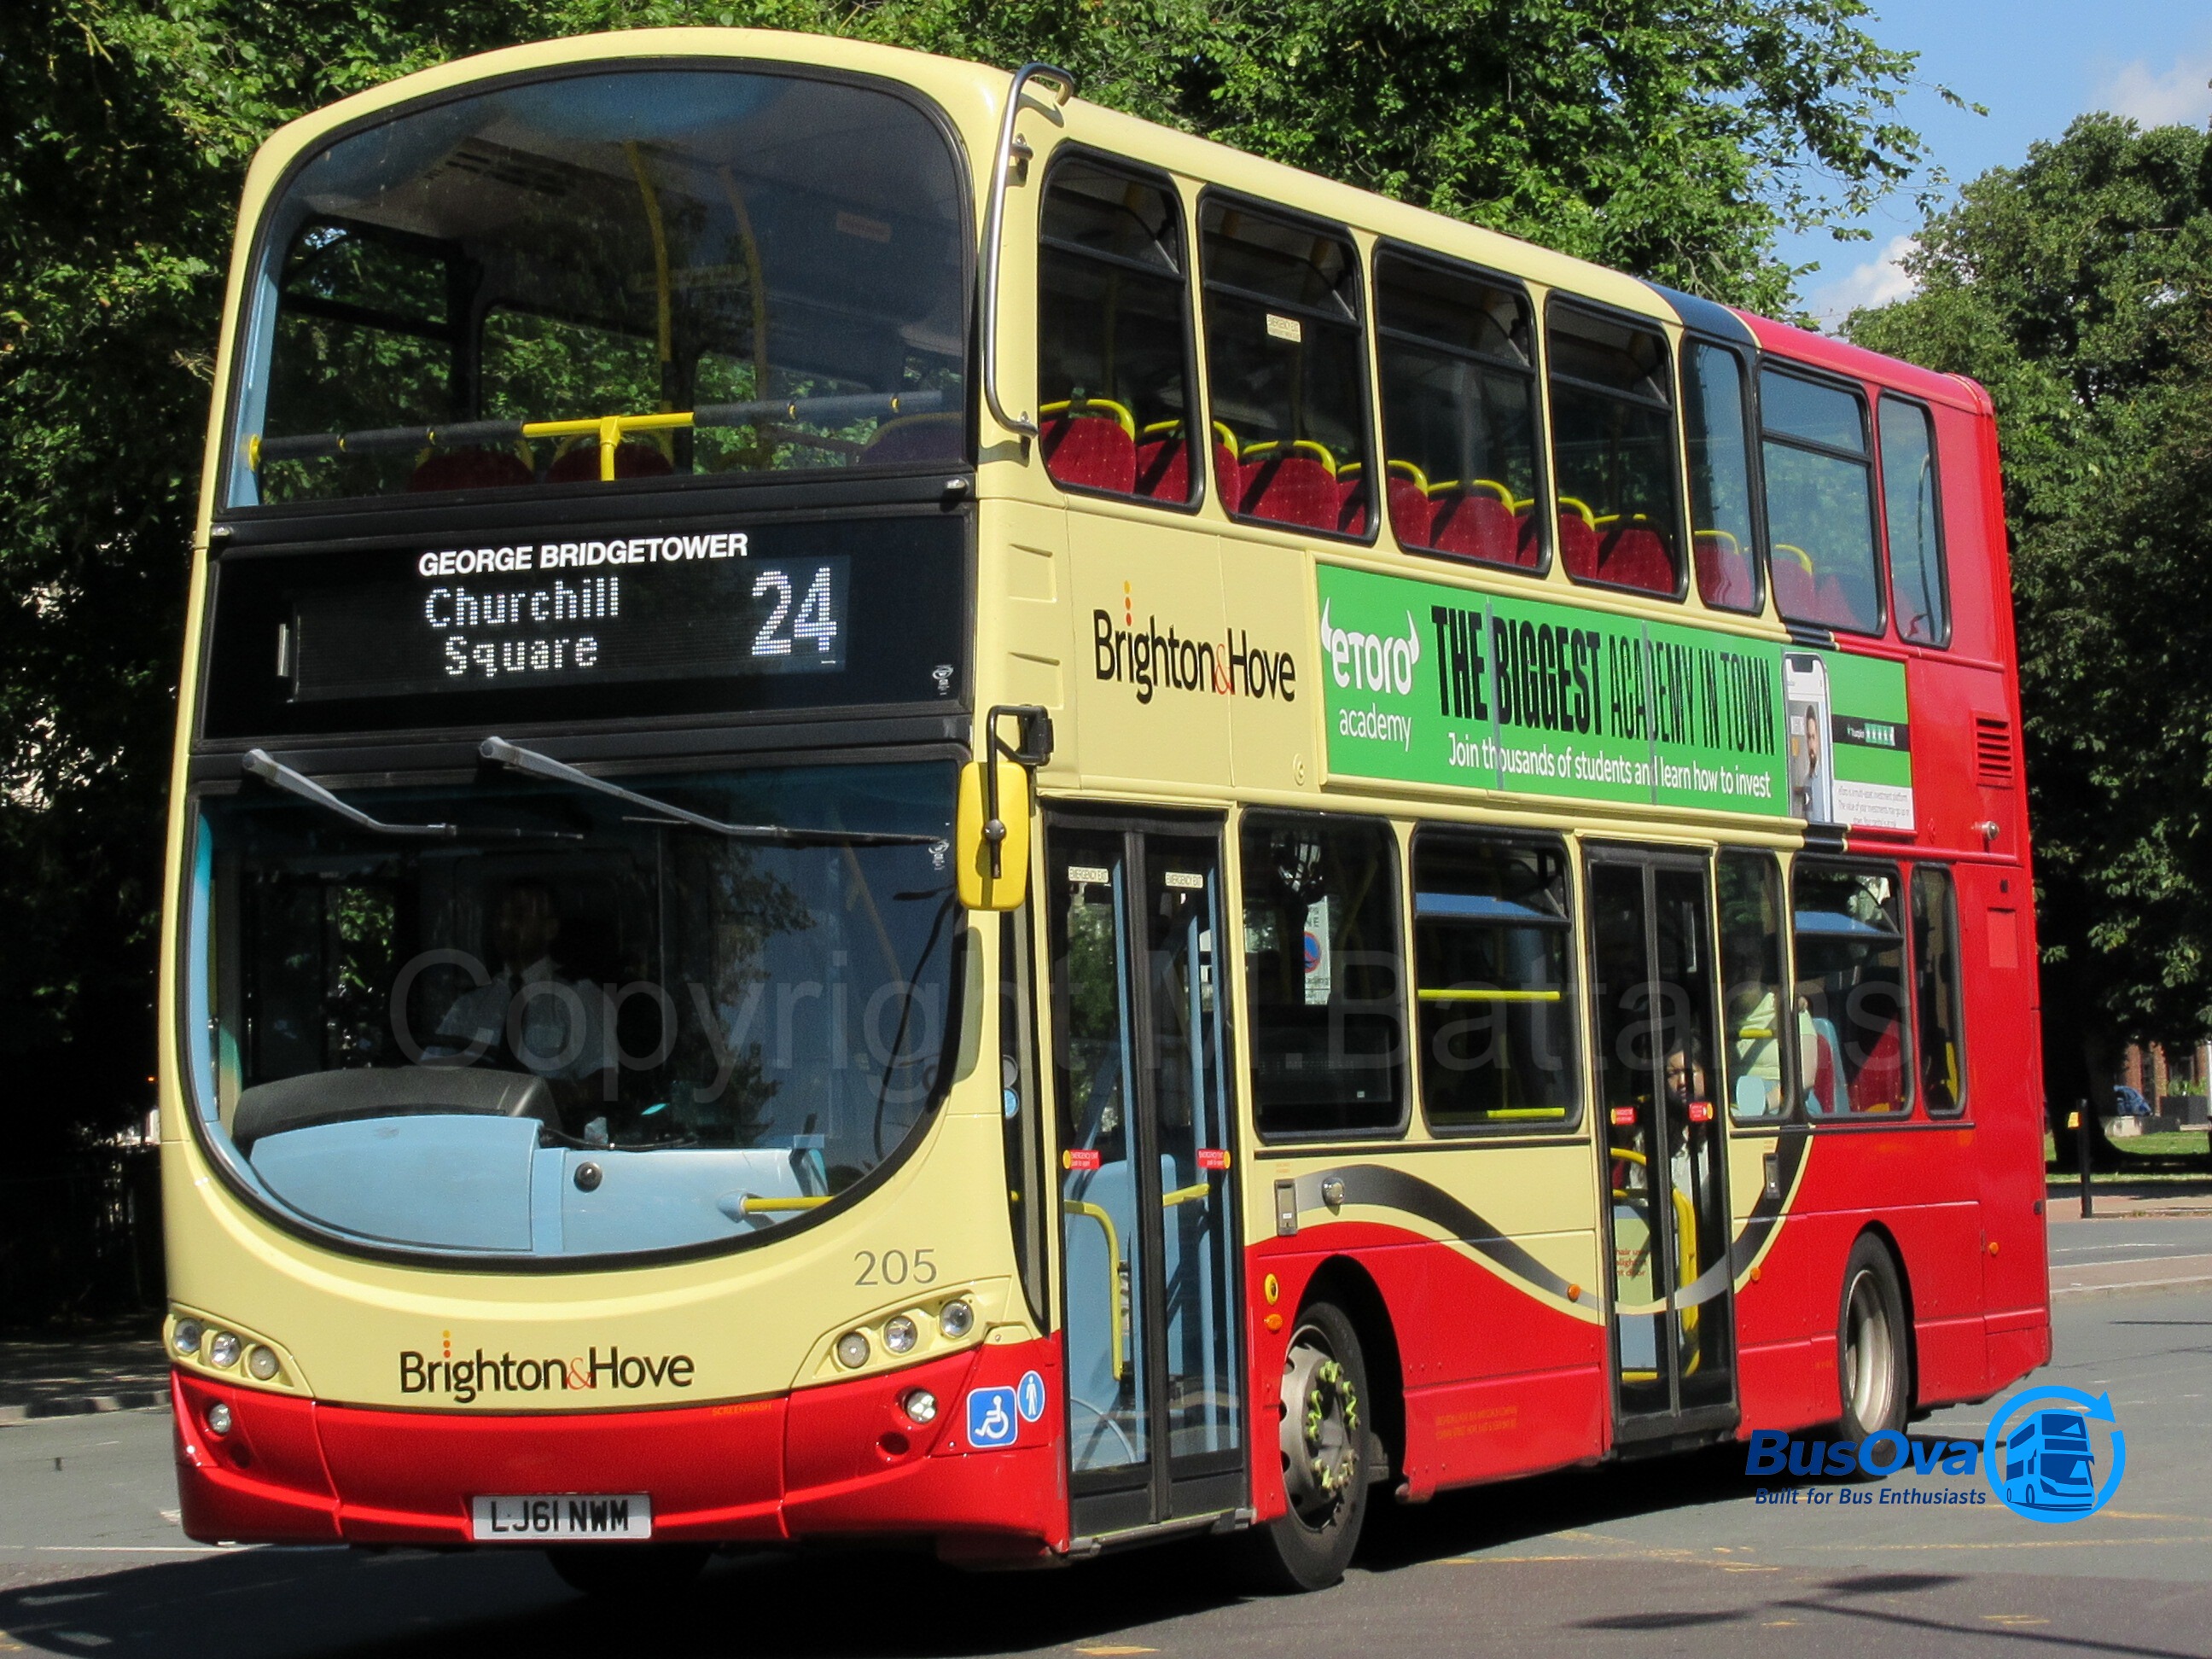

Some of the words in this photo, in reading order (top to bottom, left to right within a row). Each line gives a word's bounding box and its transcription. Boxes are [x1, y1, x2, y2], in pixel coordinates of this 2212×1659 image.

[418, 544, 533, 578] GEORGE
[538, 533, 748, 571] BRIDGETOWER
[424, 576, 620, 630] Churchill
[750, 566, 838, 656] 24
[444, 632, 598, 679] Square
[1093, 580, 1296, 704] Brighton&Hove
[1431, 605, 1487, 721] THE
[1492, 615, 1602, 736] BIGGEST
[1609, 634, 1694, 746] ACADEMY
[1697, 648, 1720, 749] IN
[1720, 652, 1774, 756] TOWN
[1339, 702, 1412, 751] academy
[1448, 732, 1480, 768] Join
[1481, 736, 1555, 777] thousands
[1557, 746, 1572, 778] of
[1575, 750, 1632, 785] students
[1634, 754, 1658, 786] and
[1660, 756, 1691, 790] learn
[1692, 760, 1718, 793] how
[1720, 765, 1734, 795] to
[1735, 765, 1772, 798] invest
[854, 1248, 937, 1286] 205
[399, 1330, 694, 1402] Brighton&Hove
[489, 1495, 560, 1534] LJ61
[567, 1493, 630, 1531] NWM
